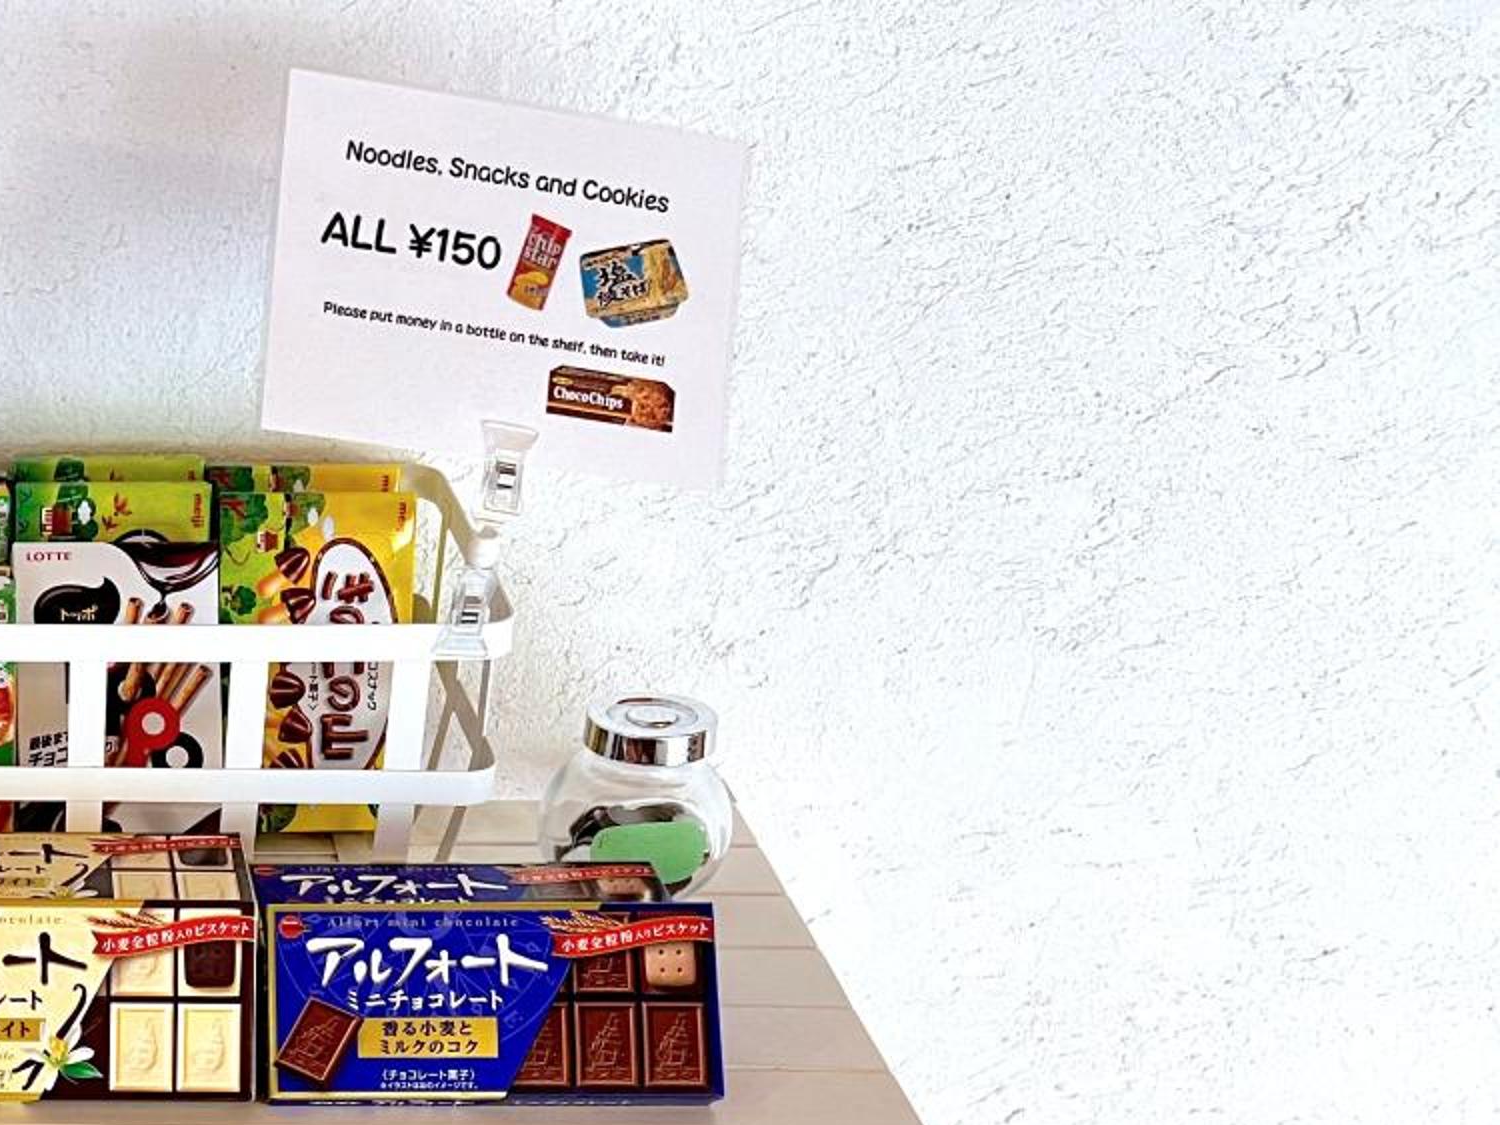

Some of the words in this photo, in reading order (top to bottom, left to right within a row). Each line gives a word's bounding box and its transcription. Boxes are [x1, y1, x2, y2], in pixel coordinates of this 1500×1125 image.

[449, 157, 530, 189] Snacks
[536, 174, 577, 197] and
[583, 180, 669, 213] Cookies
[321, 211, 396, 254] ALL
[408, 223, 502, 270] ¥150
[324, 301, 367, 319] Please
[370, 310, 393, 326] put
[396, 315, 437, 331] money
[440, 320, 452, 332] in
[455, 323, 463, 334] a
[466, 324, 507, 341] bottle
[510, 333, 525, 344] on
[529, 333, 549, 347] the
[589, 343, 617, 358] then
[621, 350, 649, 364] take
[554, 385, 624, 410] ChocoChips
[26, 551, 73, 561] LOTTE
[280, 874, 508, 895] アルフォート
[306, 935, 548, 988] アルフォート
[348, 991, 504, 1010] ミニチョコレート
[381, 1021, 473, 1037] 香る小麦と
